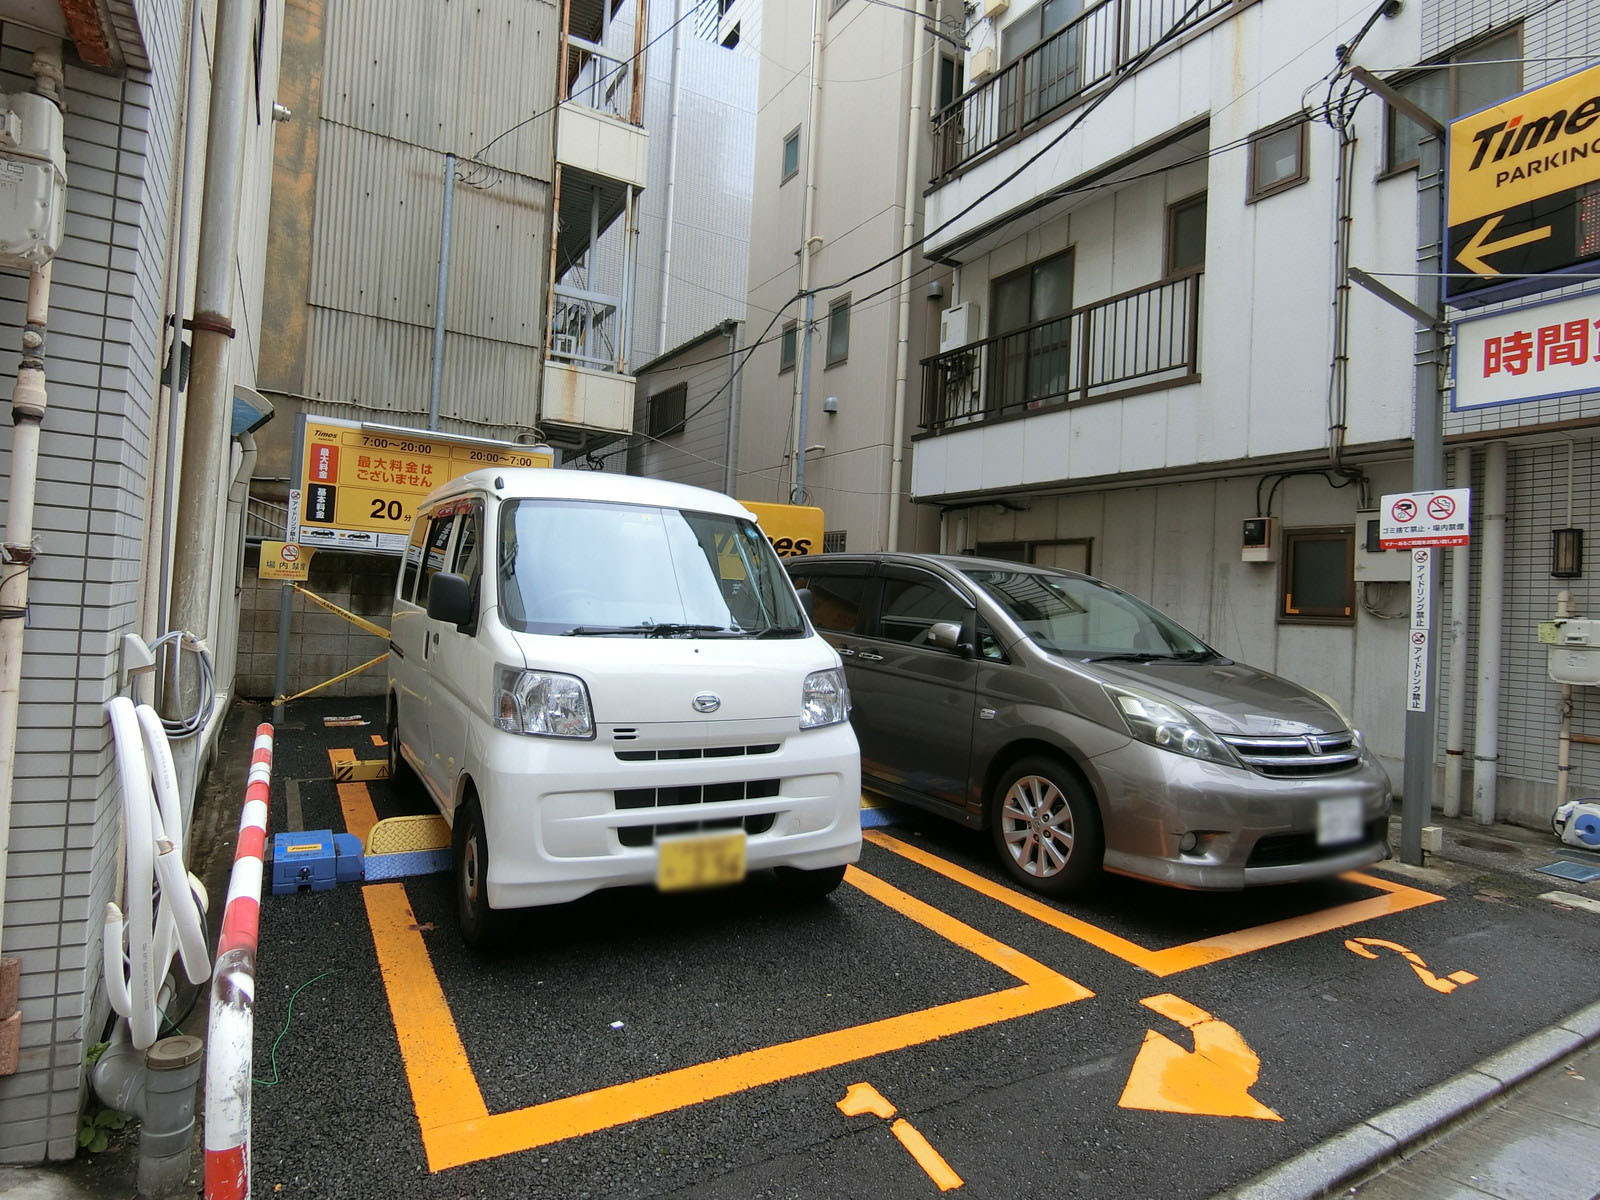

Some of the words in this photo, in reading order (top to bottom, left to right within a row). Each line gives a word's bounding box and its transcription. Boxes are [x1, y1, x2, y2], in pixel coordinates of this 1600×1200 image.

[1483, 318, 1600, 378] 時間
[318, 447, 330, 479] 最大料金
[356, 469, 433, 488] ございません
[357, 455, 433, 475] 最大料金は
[315, 487, 327, 519] 基本料金
[370, 498, 403, 521] 20
[404, 514, 412, 522] 分
[288, 501, 299, 542] アイドリング禁止
[1415, 565, 1425, 627] アイドリング禁止
[1412, 647, 1422, 709] アイドリング禁止
[836, 1081, 965, 1192] 1
